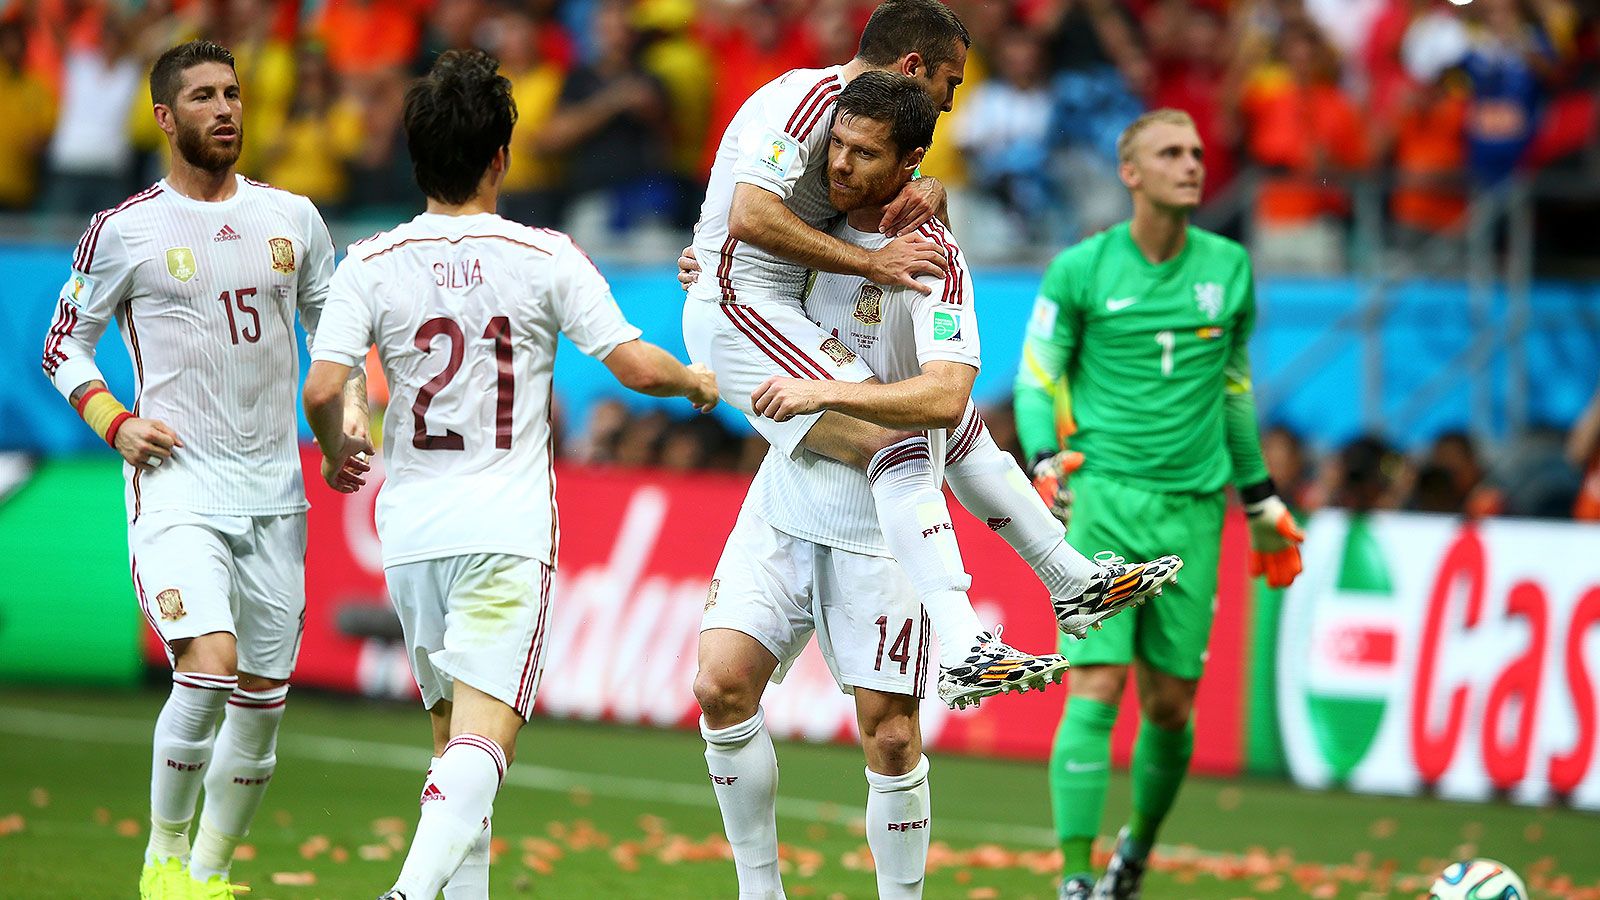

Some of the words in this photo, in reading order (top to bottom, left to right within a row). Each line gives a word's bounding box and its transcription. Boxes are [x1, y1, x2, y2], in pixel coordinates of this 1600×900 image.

[213, 233, 241, 243] adidas
[433, 258, 483, 289] SILVA
[218, 287, 261, 345] 15
[1155, 331, 1175, 377] 1
[412, 316, 516, 451] 21
[874, 615, 914, 675] 14
[887, 818, 929, 832] RFEF
